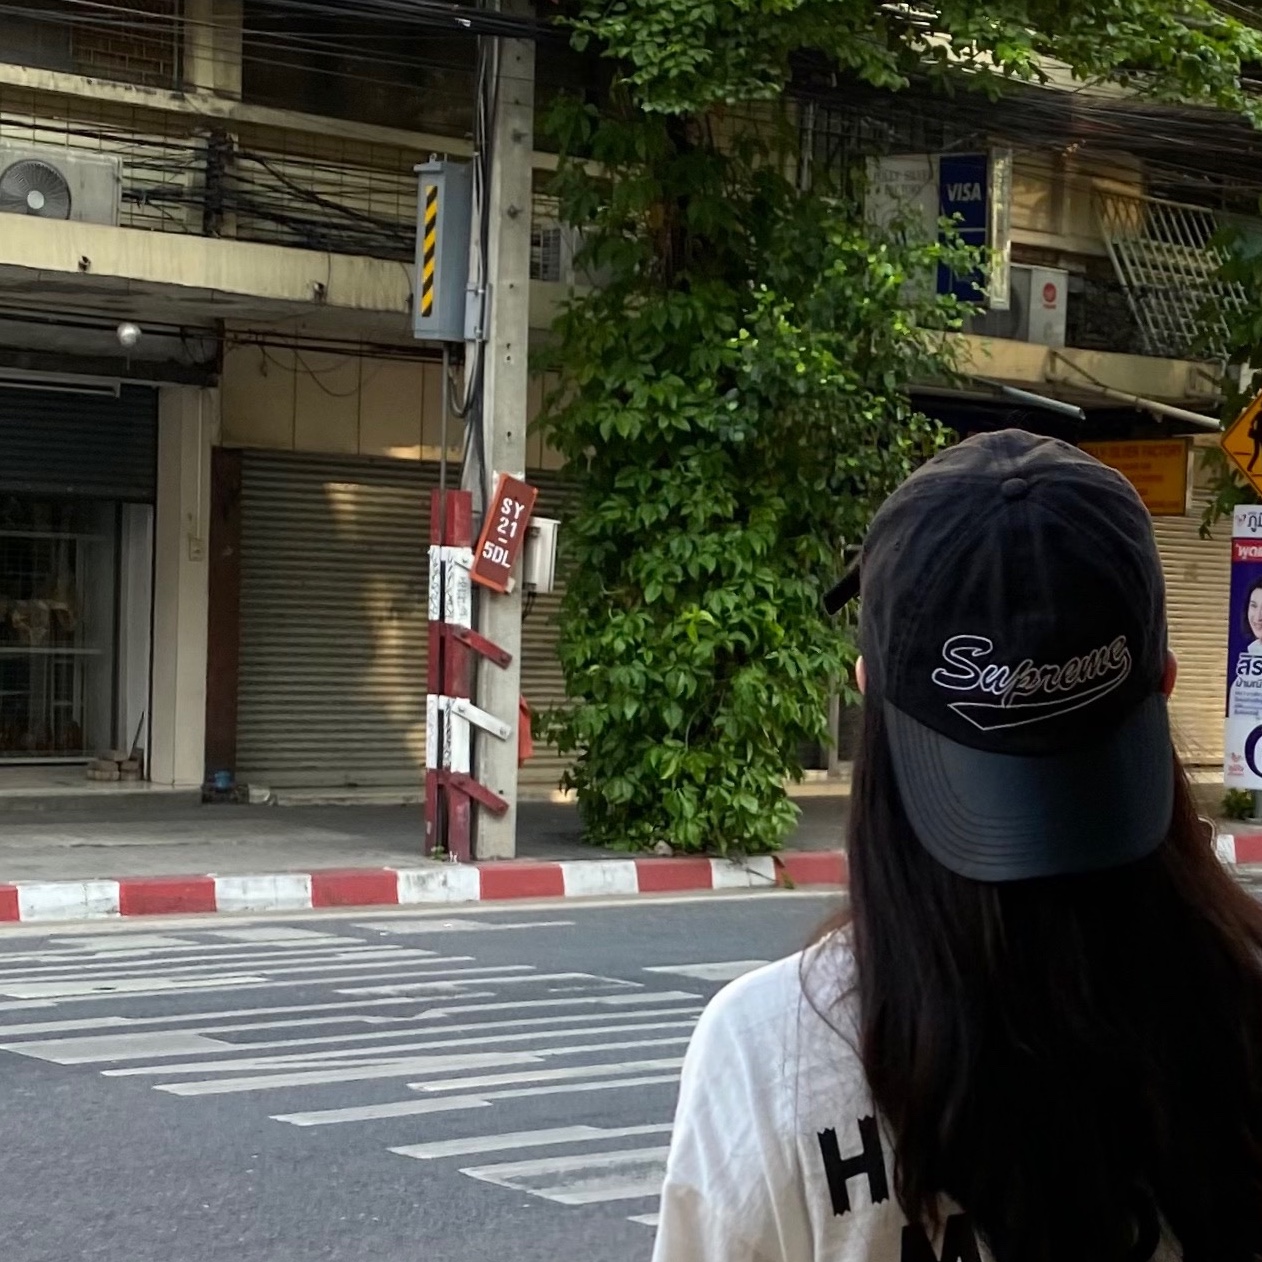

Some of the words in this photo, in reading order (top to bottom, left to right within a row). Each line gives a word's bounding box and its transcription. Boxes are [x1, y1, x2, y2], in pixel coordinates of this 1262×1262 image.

[947, 182, 982, 201] VISA
[500, 497, 524, 520] SY
[497, 517, 518, 538] 21
[482, 540, 511, 569] 5DL
[931, 635, 1132, 708] Supreme
